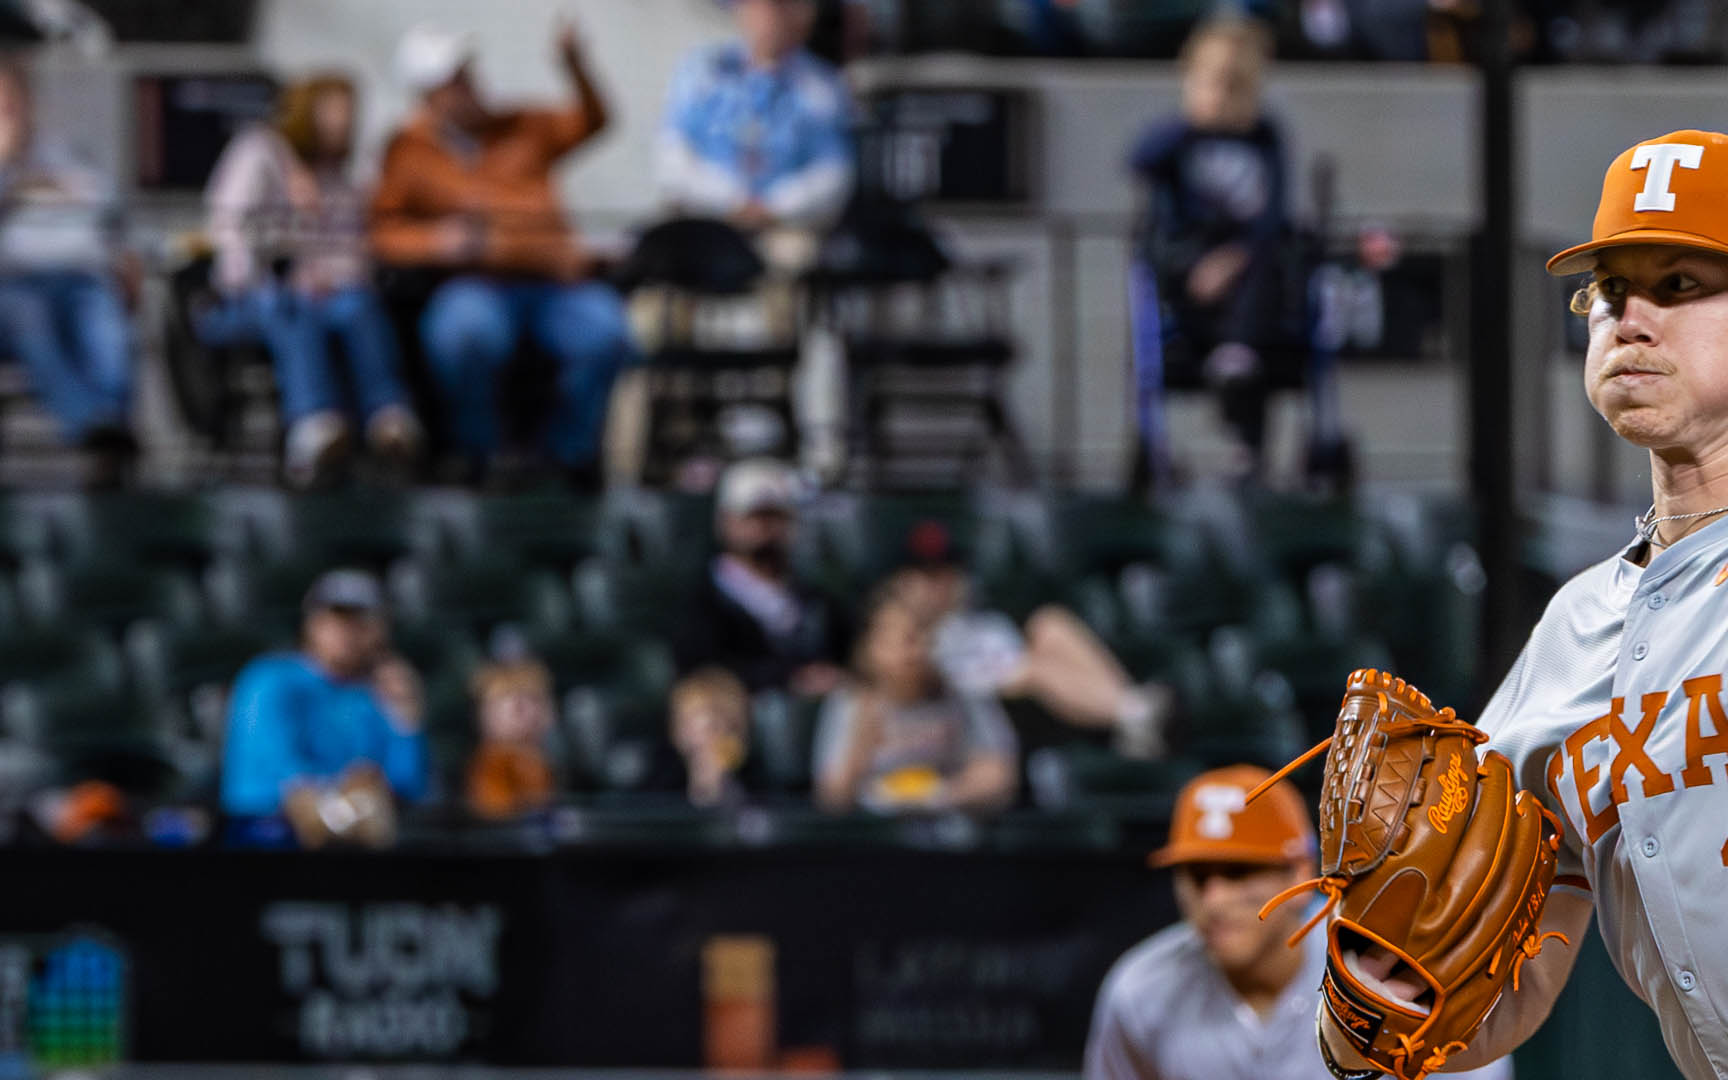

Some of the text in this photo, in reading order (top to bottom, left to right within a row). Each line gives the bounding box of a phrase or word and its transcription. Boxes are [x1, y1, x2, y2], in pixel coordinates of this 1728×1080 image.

[1630, 143, 1704, 213] T
[1193, 784, 1246, 840] T
[1428, 751, 1468, 835] Rawlings
